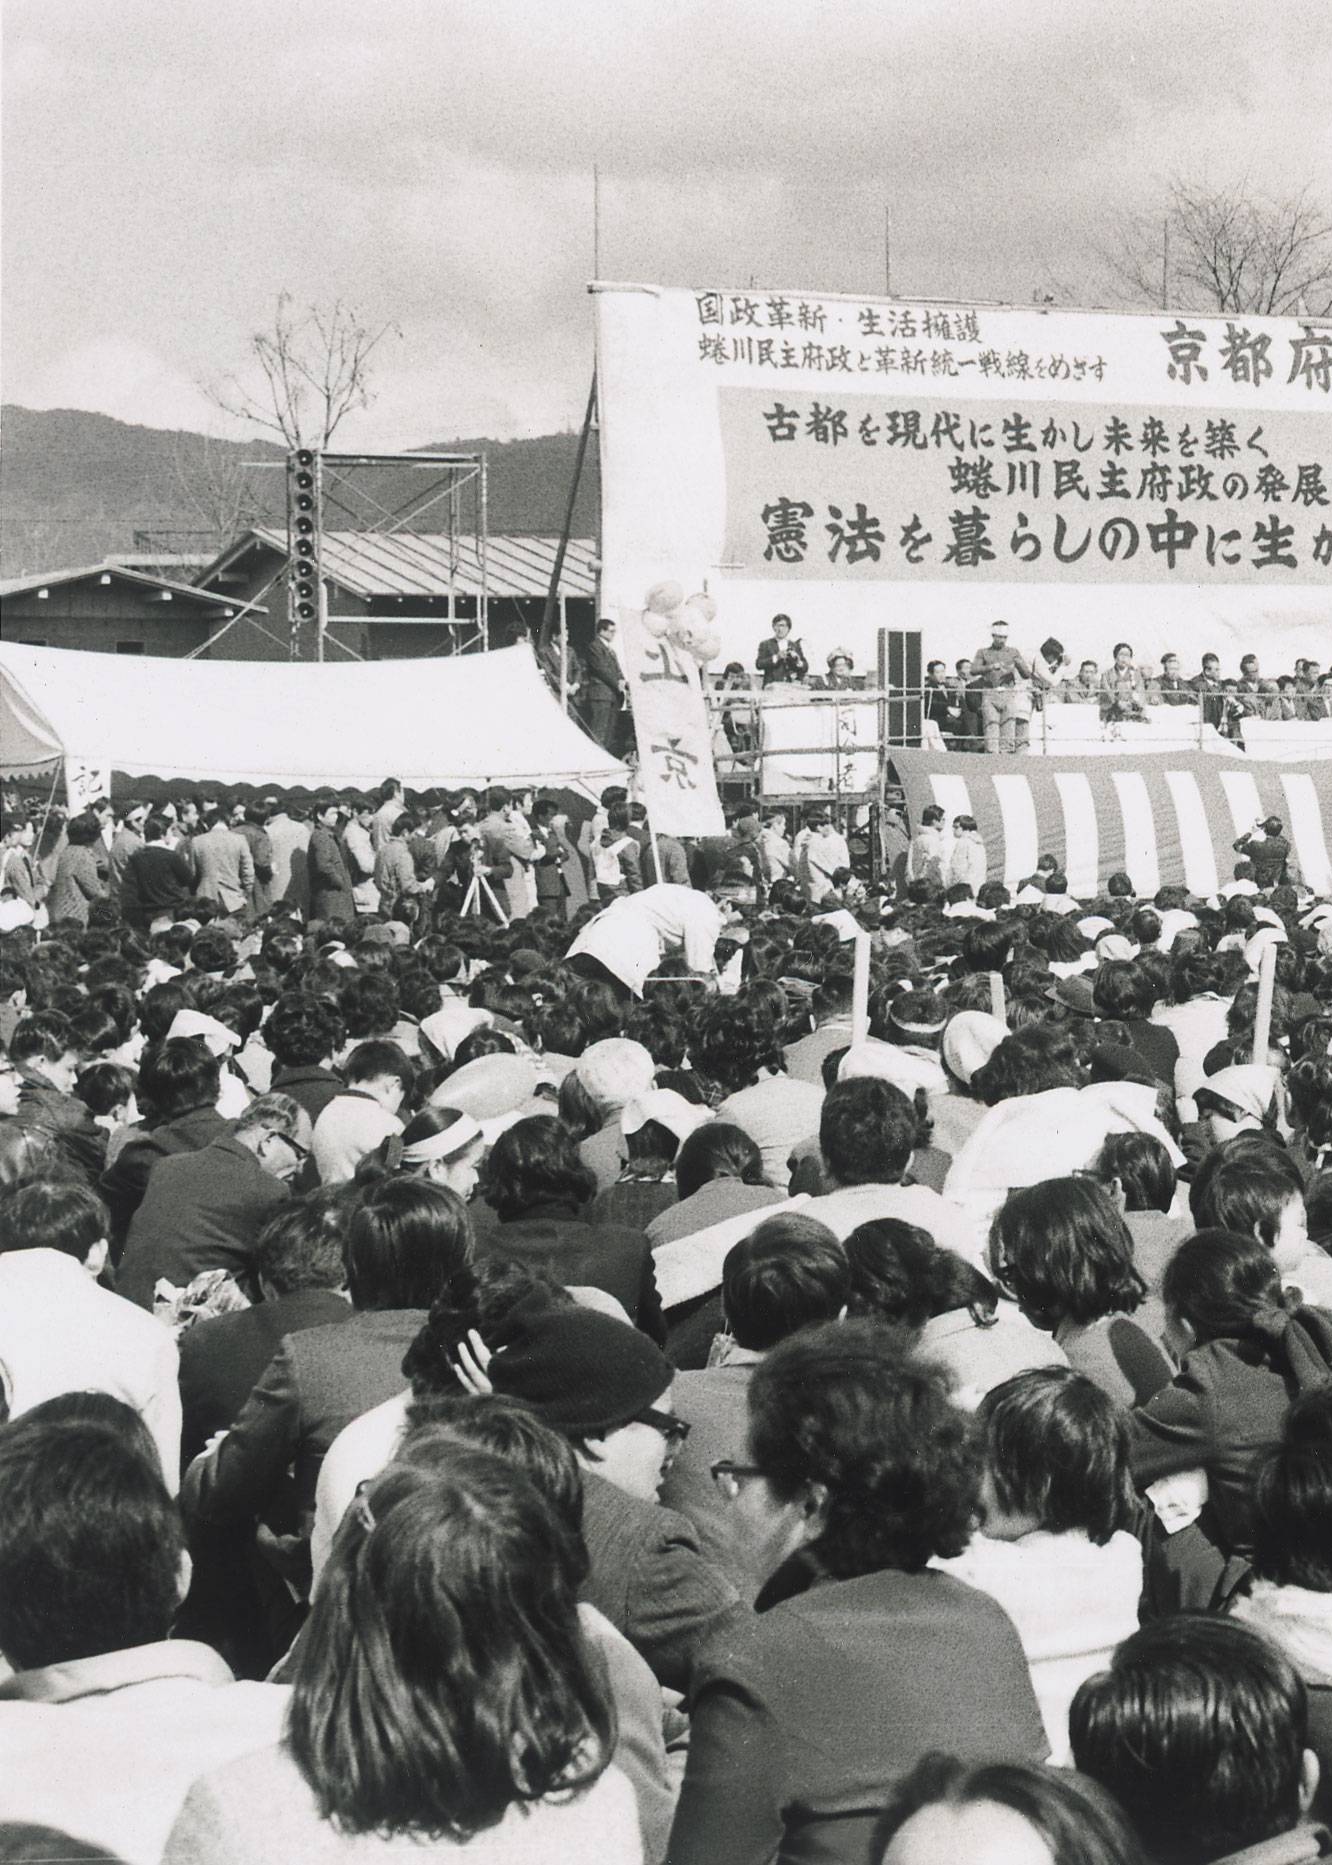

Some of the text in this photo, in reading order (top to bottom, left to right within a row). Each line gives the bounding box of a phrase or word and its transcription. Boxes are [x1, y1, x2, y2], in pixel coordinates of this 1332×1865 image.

[697, 332, 1109, 382] 蜷川民主府政と革新統一戦線をめざす
[762, 400, 1268, 459] 古都を現代に生かし未来を築く
